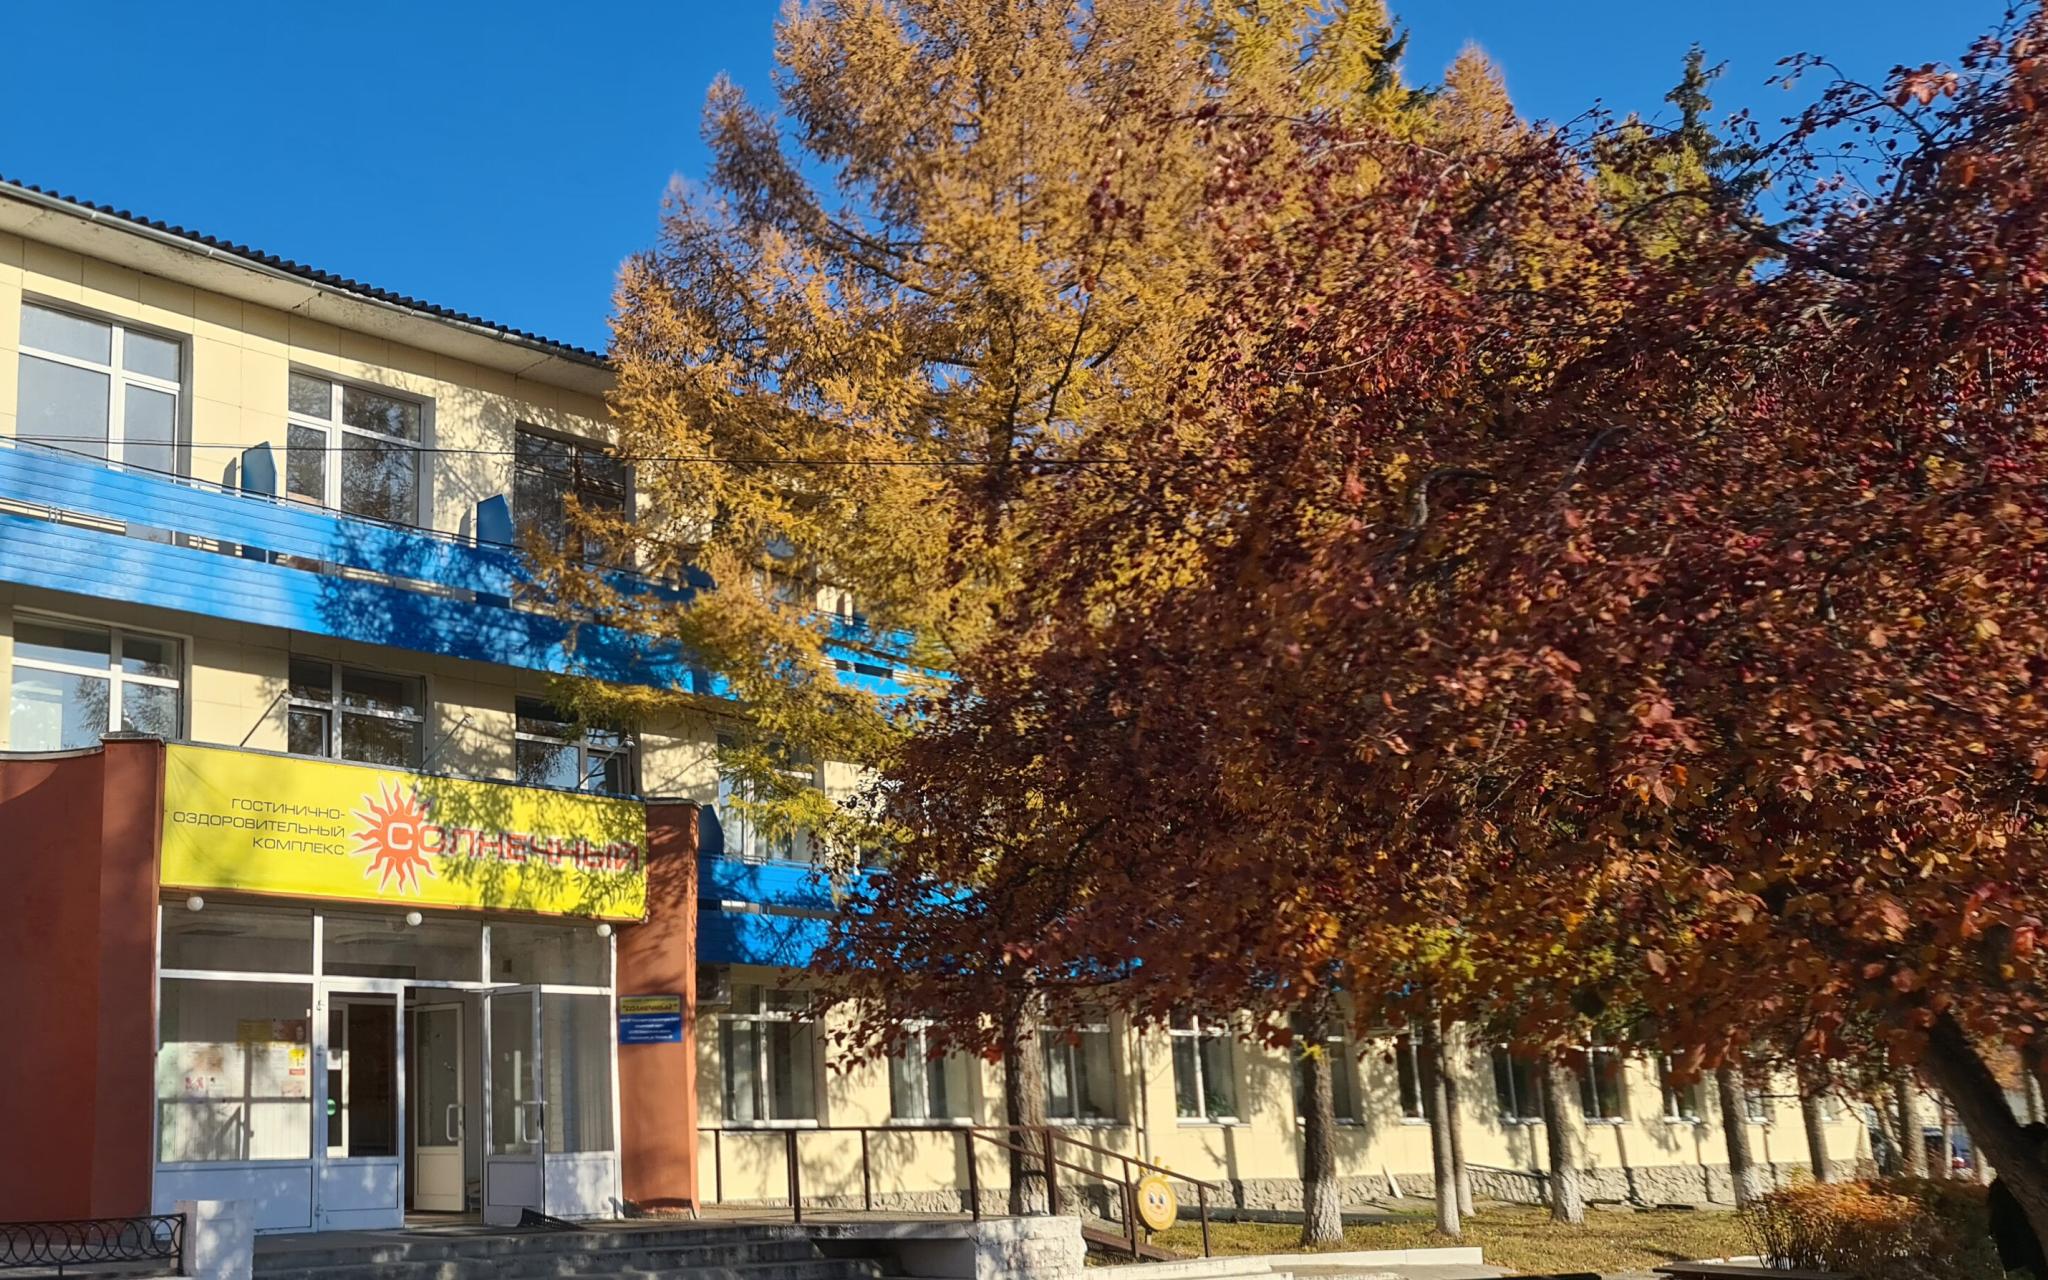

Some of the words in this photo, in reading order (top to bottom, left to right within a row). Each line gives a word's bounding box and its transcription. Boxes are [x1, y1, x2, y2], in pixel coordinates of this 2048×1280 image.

[231, 798, 345, 820] ГОСТИНИЧНО-
[173, 811, 345, 838] ОЗДОРОВИТЕЛЬНЫЙ
[252, 837, 345, 856] КОМПЛЕКС
[387, 822, 640, 871] СОЛНЕЧНЫЙ
